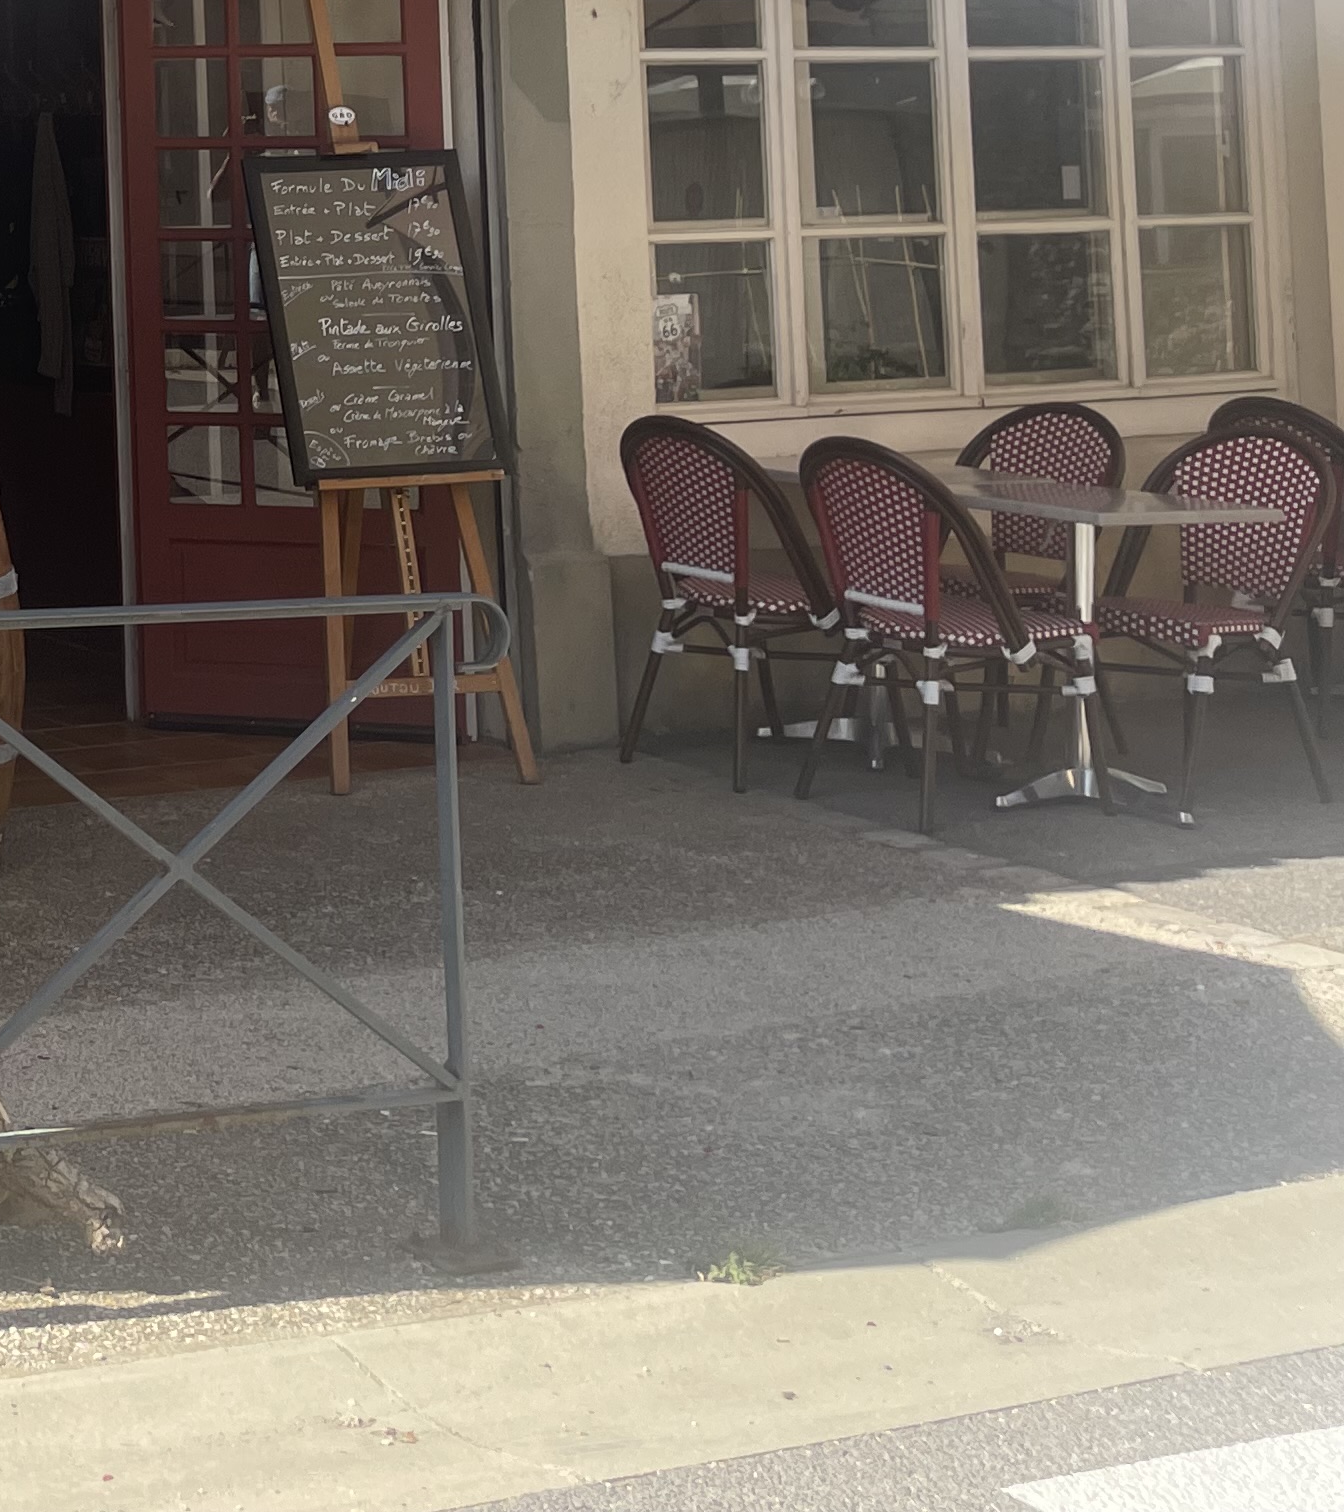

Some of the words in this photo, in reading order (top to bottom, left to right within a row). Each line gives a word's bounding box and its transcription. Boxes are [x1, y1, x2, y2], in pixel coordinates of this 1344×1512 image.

[270, 177, 333, 194] Formule
[340, 177, 366, 191] Du
[371, 168, 425, 192] Midi
[333, 201, 376, 216] Plat
[275, 230, 314, 246] Plat
[330, 225, 395, 243] Dessert
[318, 317, 371, 337] Pintade
[406, 314, 464, 332] Girolles
[663, 324, 677, 338] 66
